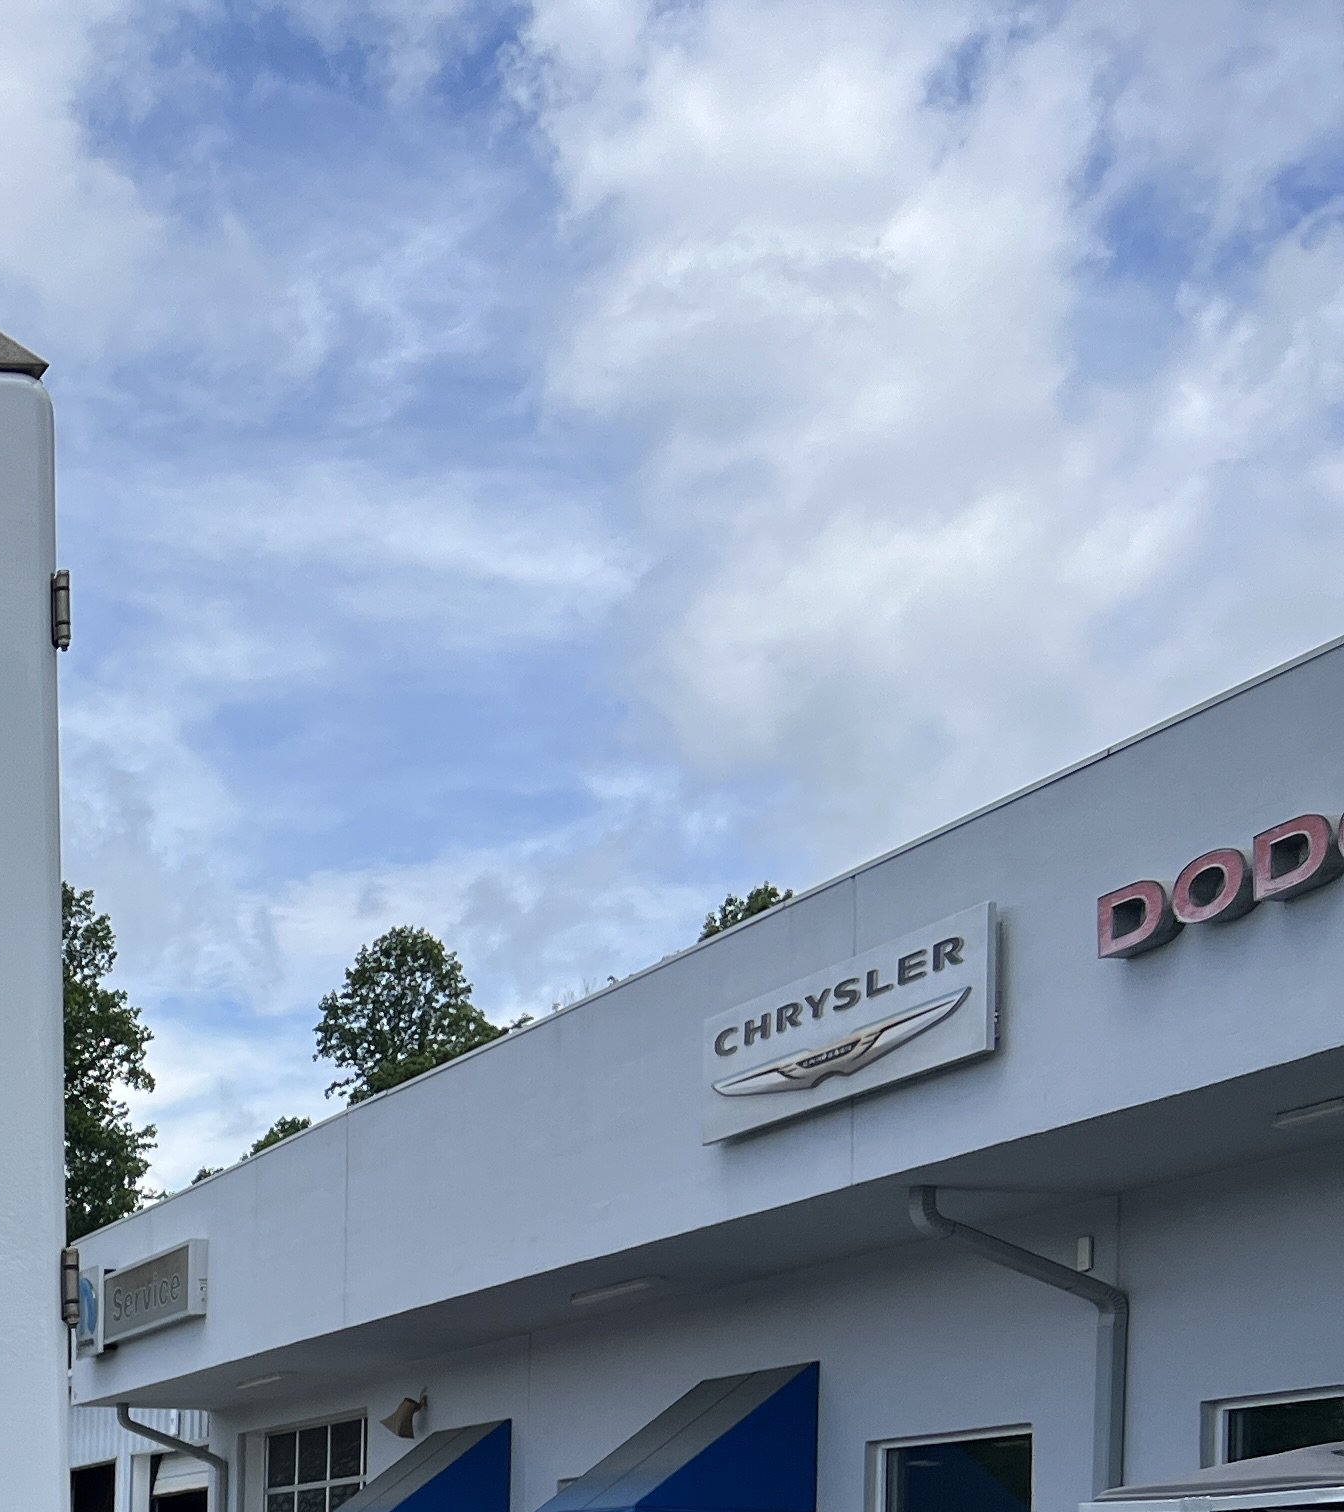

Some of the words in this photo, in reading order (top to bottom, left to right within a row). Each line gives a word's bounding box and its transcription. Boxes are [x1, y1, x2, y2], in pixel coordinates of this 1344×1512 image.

[1097, 812, 1344, 960] DOD
[714, 936, 965, 1057] CHRYSLER
[112, 1272, 181, 1321] Service
